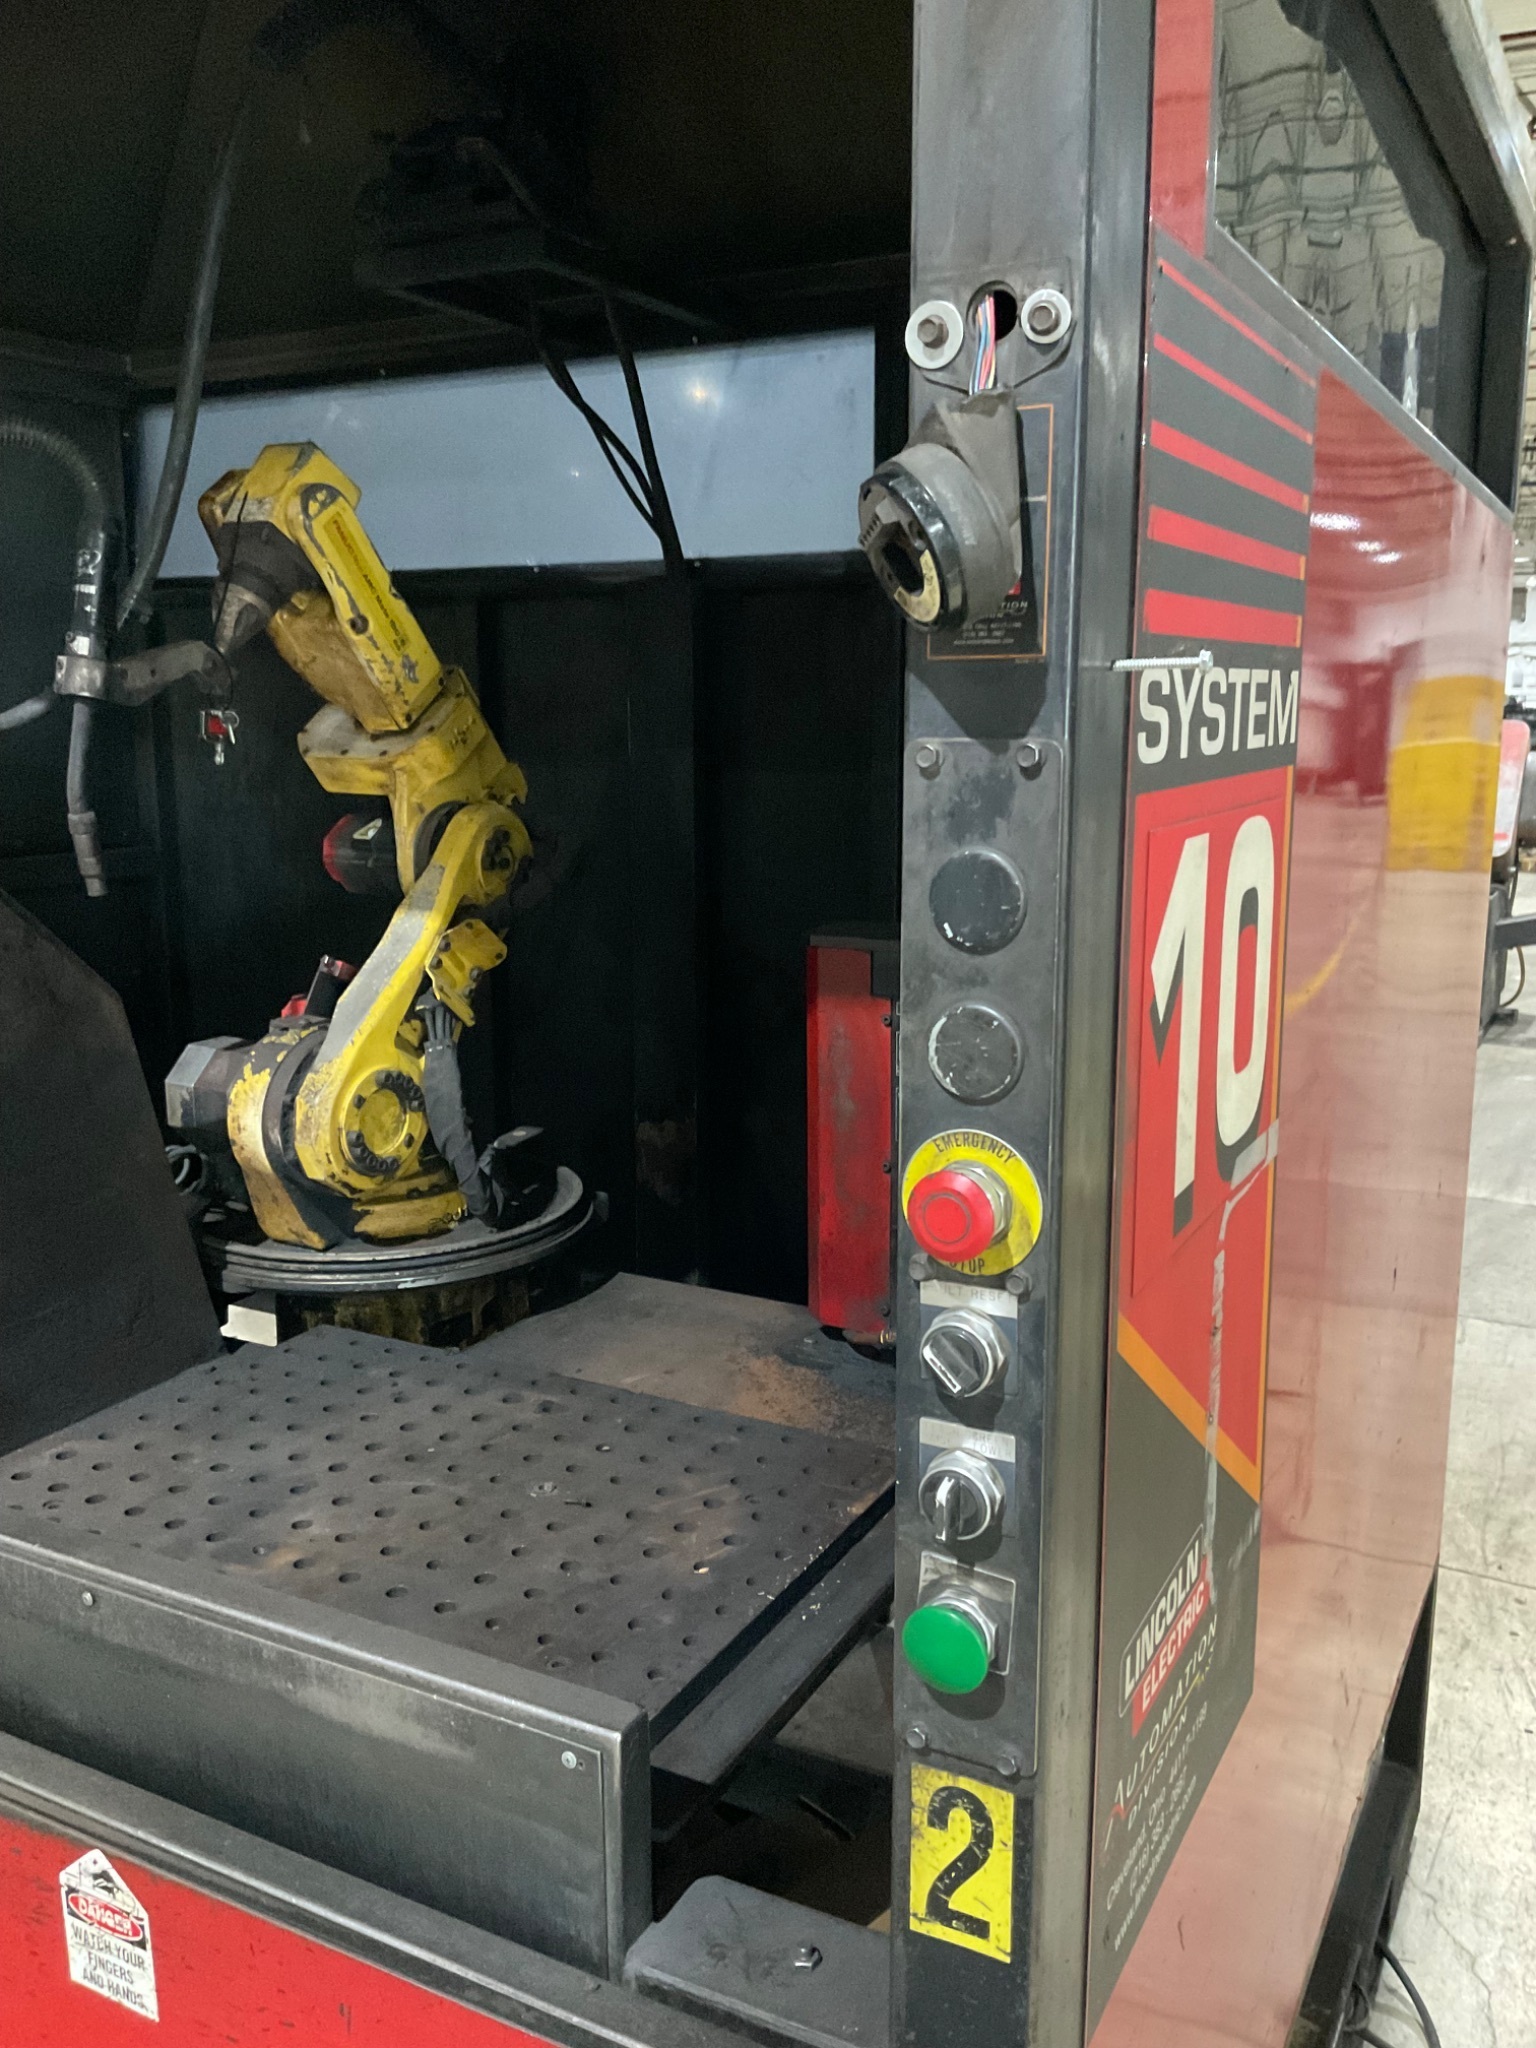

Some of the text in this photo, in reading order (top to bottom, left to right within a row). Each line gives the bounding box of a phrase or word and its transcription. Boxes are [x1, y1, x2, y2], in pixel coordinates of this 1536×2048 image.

[1137, 666, 1299, 764] SYSTEM
[1150, 814, 1275, 1200] 10
[932, 1131, 1017, 1165] EMERGENCY
[1125, 1539, 1199, 1700] LINCOLN
[1142, 1580, 1205, 1713] ELECTRIC
[1105, 1613, 1218, 1850] AUTOMATION
[1128, 1705, 1188, 1831] DIVISION
[78, 1896, 133, 1938] DANGER
[925, 1785, 995, 1941] 2
[71, 1922, 147, 1970] WATCH YOUR
[82, 1967, 105, 1989] AND
[87, 1951, 135, 1985] FINGERS
